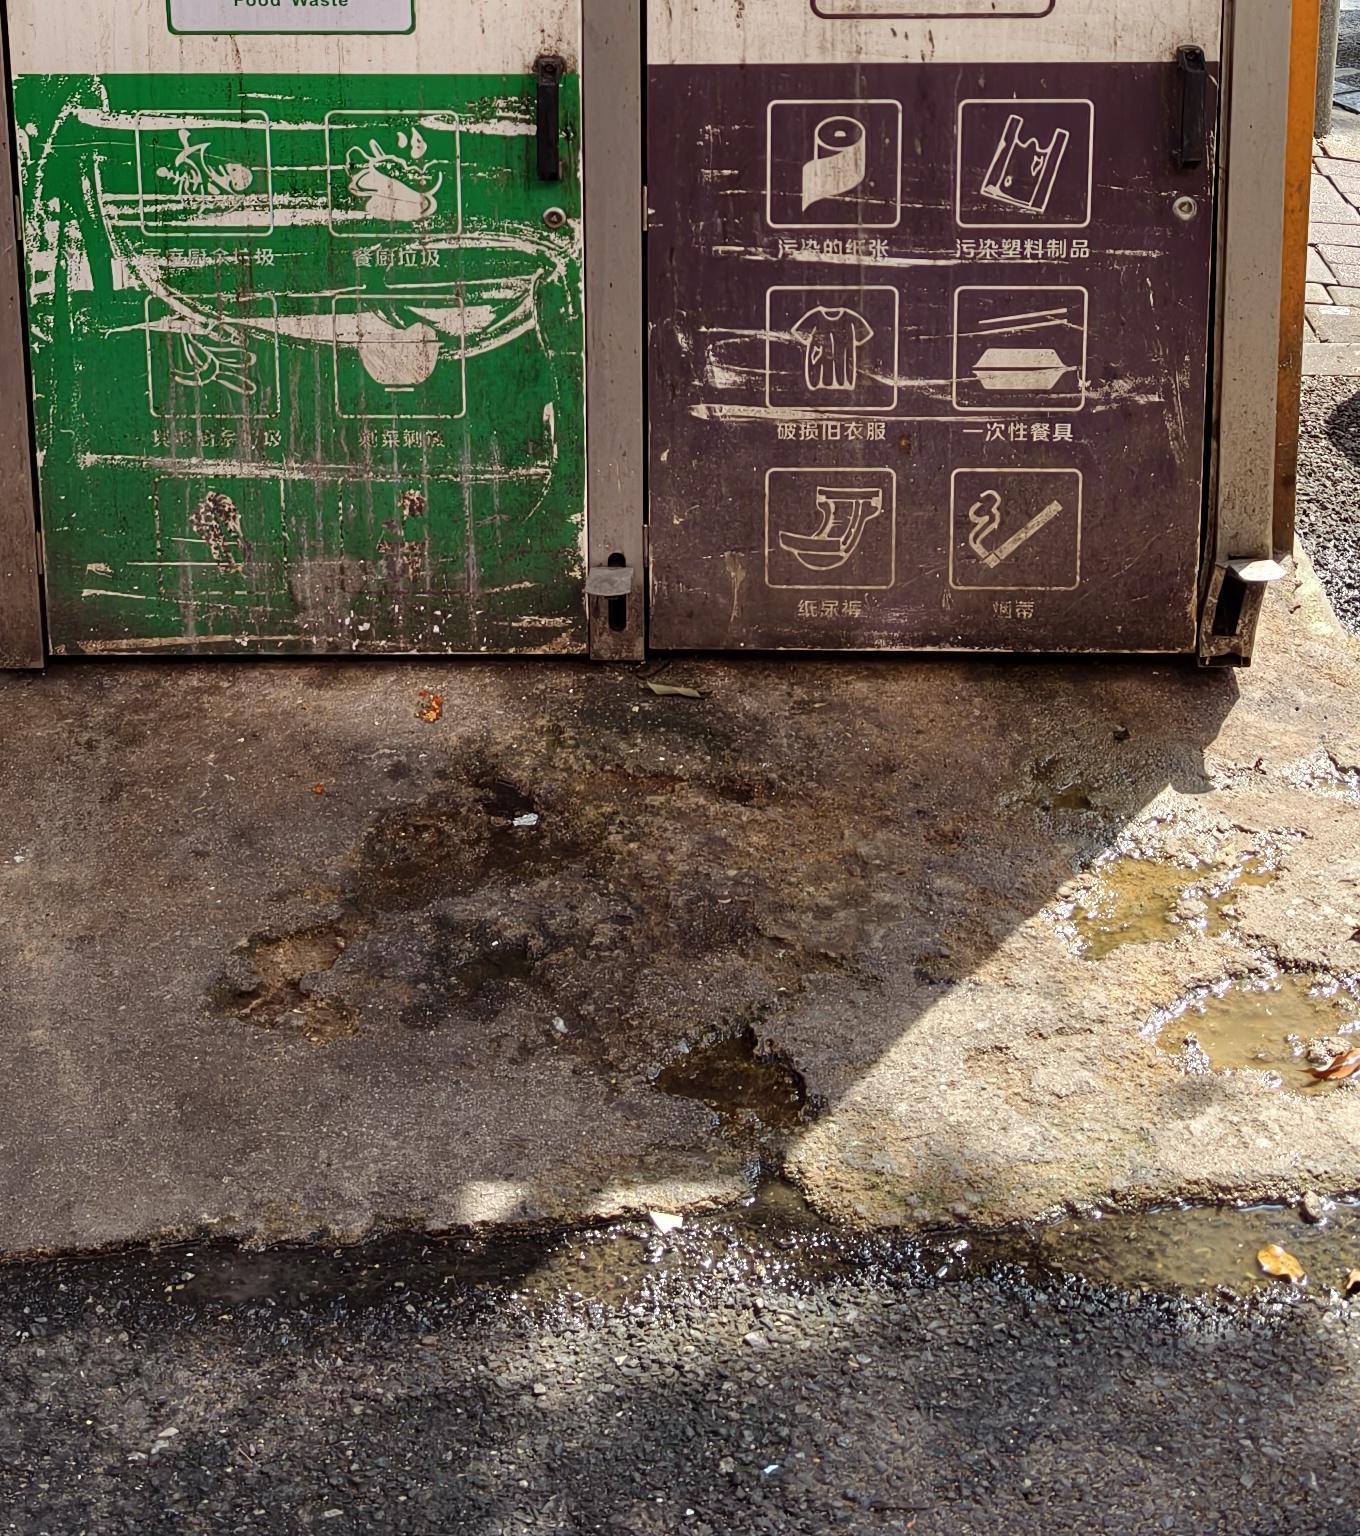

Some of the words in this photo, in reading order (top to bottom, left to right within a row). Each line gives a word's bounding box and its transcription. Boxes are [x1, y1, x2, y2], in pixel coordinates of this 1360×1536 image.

[353, 248, 441, 269] 餐厨垃圾
[777, 238, 890, 260] 污染的纸张
[955, 238, 1091, 260] 污染塑料制品
[776, 421, 888, 442] 破损旧衣服
[962, 421, 1075, 443] 一次性餐具
